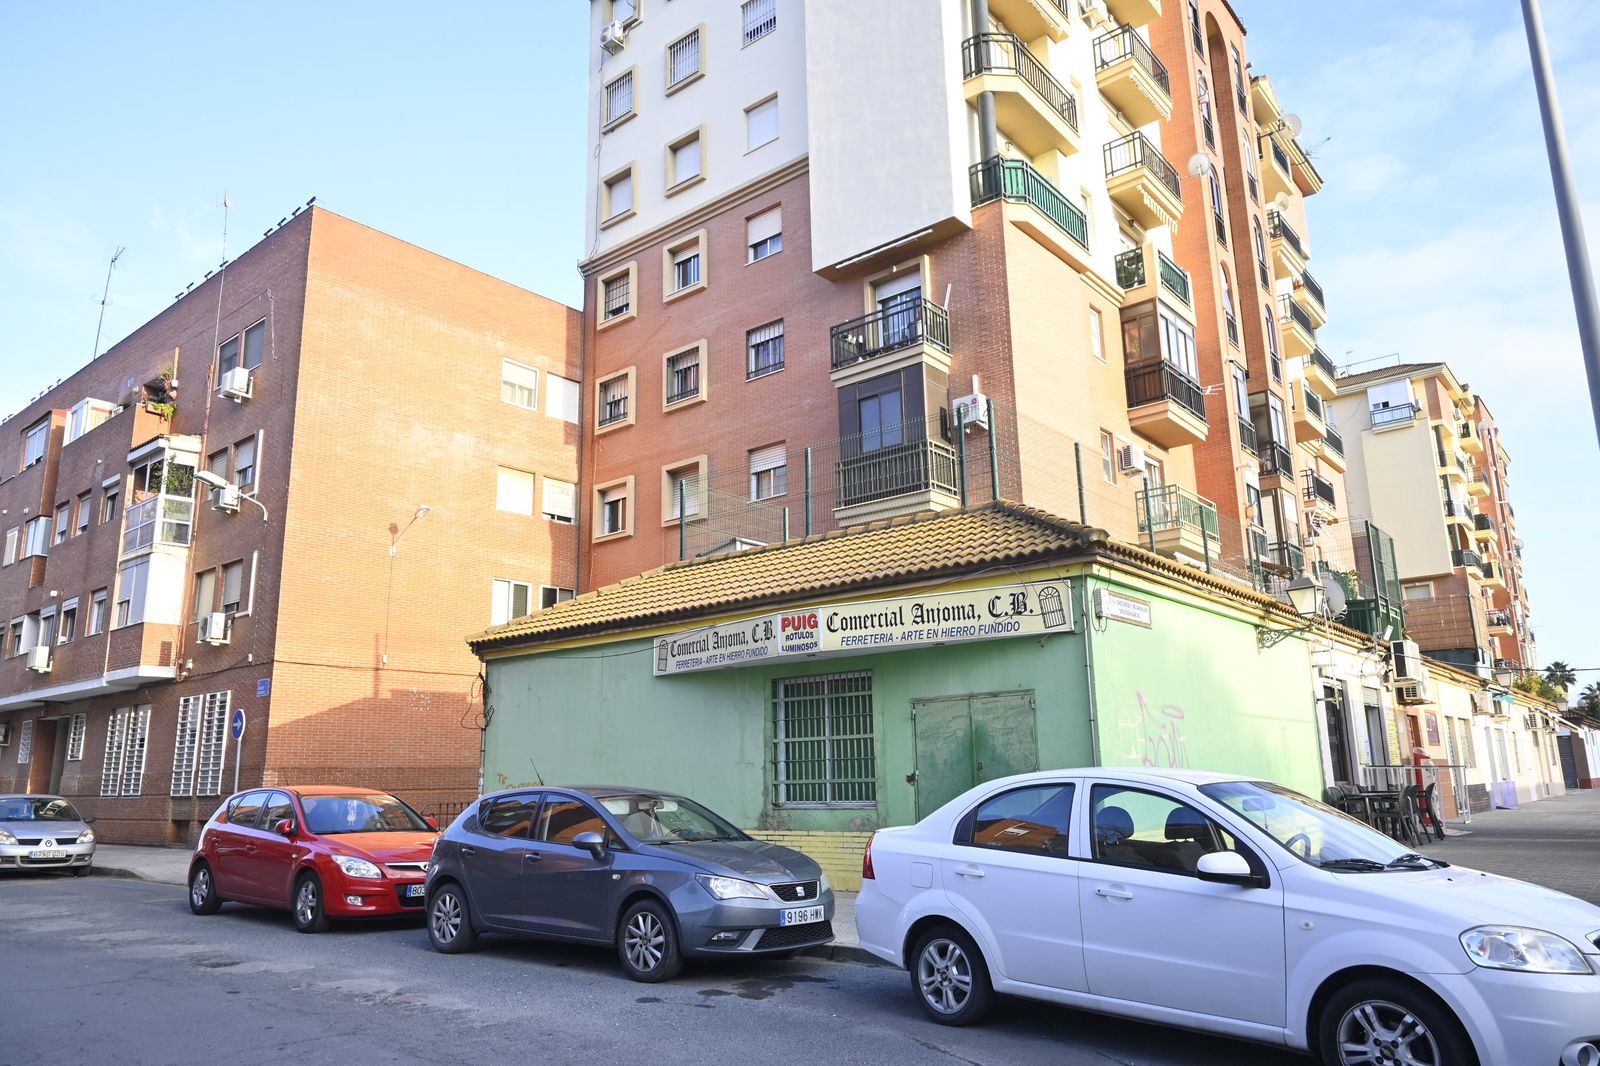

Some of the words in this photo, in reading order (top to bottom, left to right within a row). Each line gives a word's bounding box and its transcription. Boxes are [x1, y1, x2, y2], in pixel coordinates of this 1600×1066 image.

[781, 613, 818, 633] PUIG
[826, 605, 903, 633] Comercial
[911, 602, 982, 627] Anjoma,
[988, 591, 1034, 618] C.B.
[670, 637, 709, 658] Comercial
[751, 619, 776, 643] C.B.
[785, 631, 814, 642] ROTULOS
[840, 632, 894, 646] FERRETERIA
[900, 630, 925, 642] ARTE
[926, 628, 939, 639] EN
[941, 625, 976, 638] HIERRO
[978, 620, 1021, 635] FUNDIDO
[675, 657, 703, 670] FERRETERIA
[705, 654, 718, 665] ARTE
[718, 652, 726, 663] EN
[725, 649, 745, 661] HIERRO
[745, 645, 769, 659] FUNDIDO
[781, 641, 818, 652] LUMINOSOS
[786, 909, 808, 923] 9196
